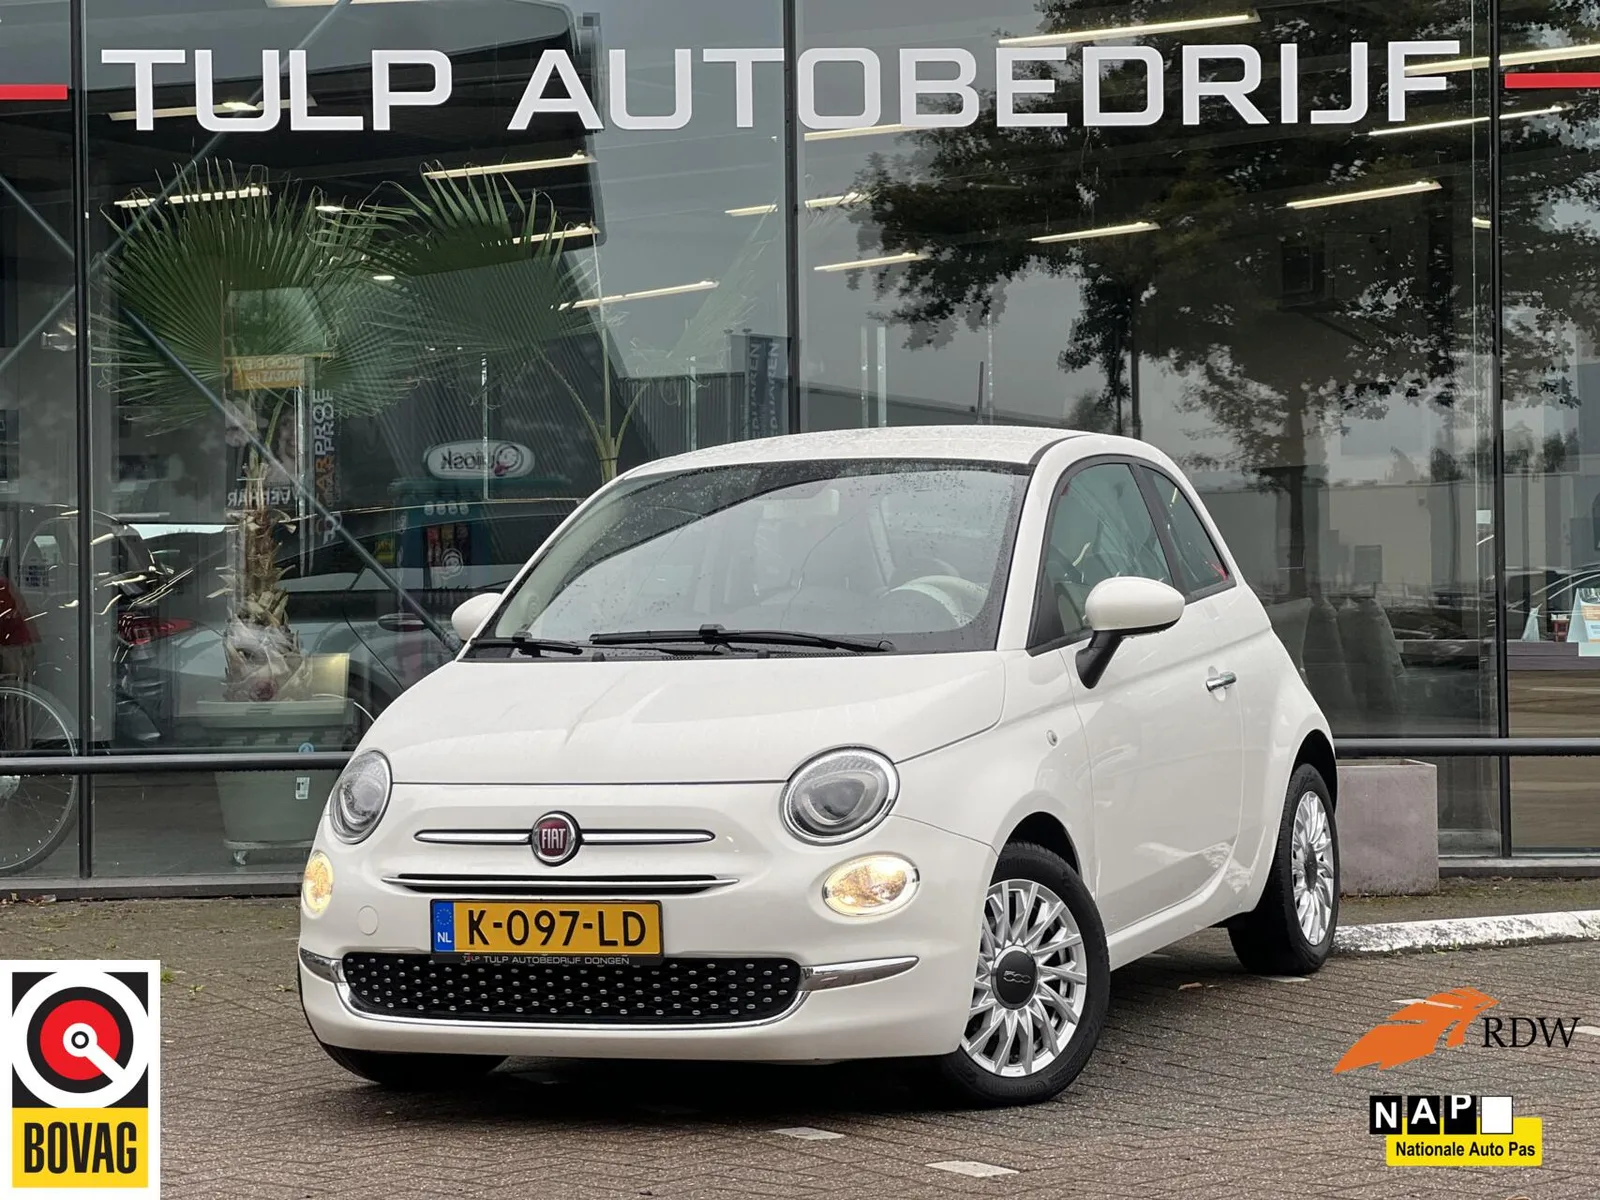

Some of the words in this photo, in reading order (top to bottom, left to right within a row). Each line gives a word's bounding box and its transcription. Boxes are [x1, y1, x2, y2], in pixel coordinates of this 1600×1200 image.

[101, 49, 452, 132] TULP
[507, 40, 1460, 130] AUTOBEDRIJF
[541, 828, 566, 849] FIAT
[437, 932, 452, 943] NL
[468, 909, 646, 947] K-097-LD
[484, 955, 509, 963] TULP
[512, 956, 581, 964] AUTOBEDRIJF
[584, 956, 630, 965] DONGEN
